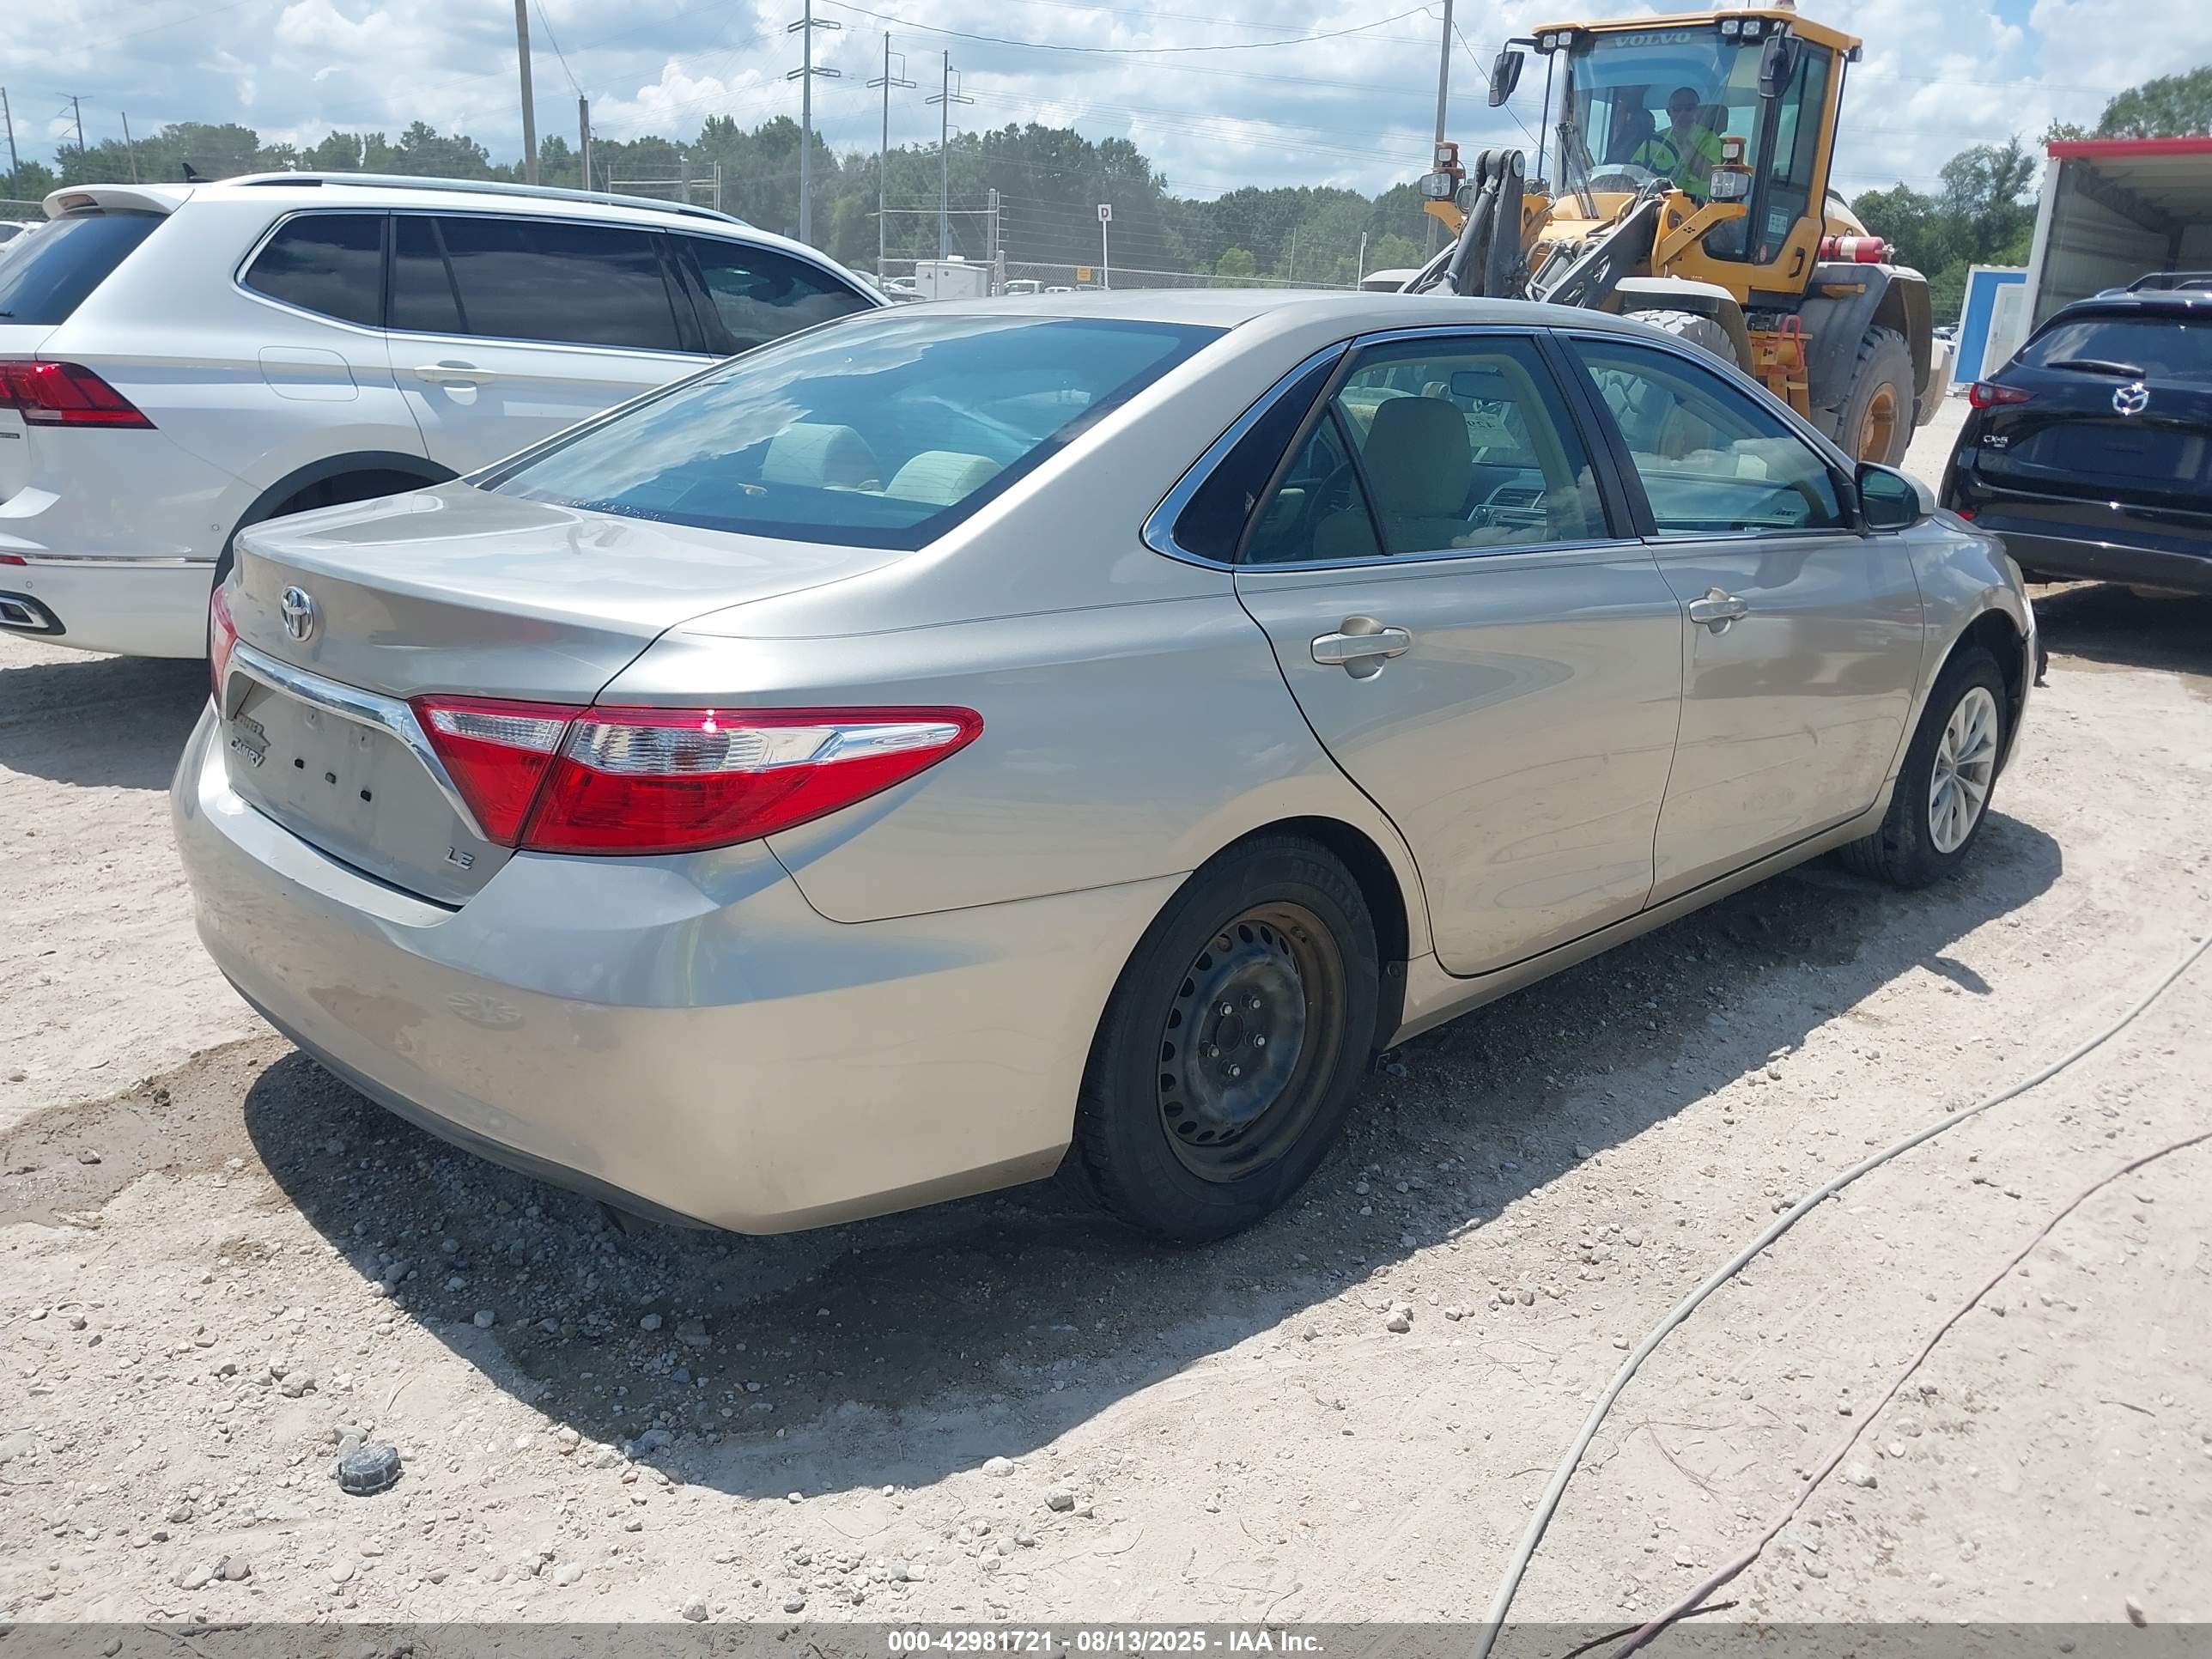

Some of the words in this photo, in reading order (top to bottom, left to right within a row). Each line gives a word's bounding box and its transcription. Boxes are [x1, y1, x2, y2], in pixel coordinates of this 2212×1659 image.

[1614, 32, 1691, 48] VOLVO
[1101, 207, 1109, 218] D
[229, 737, 264, 767] CAMRY
[445, 847, 475, 870] LE
